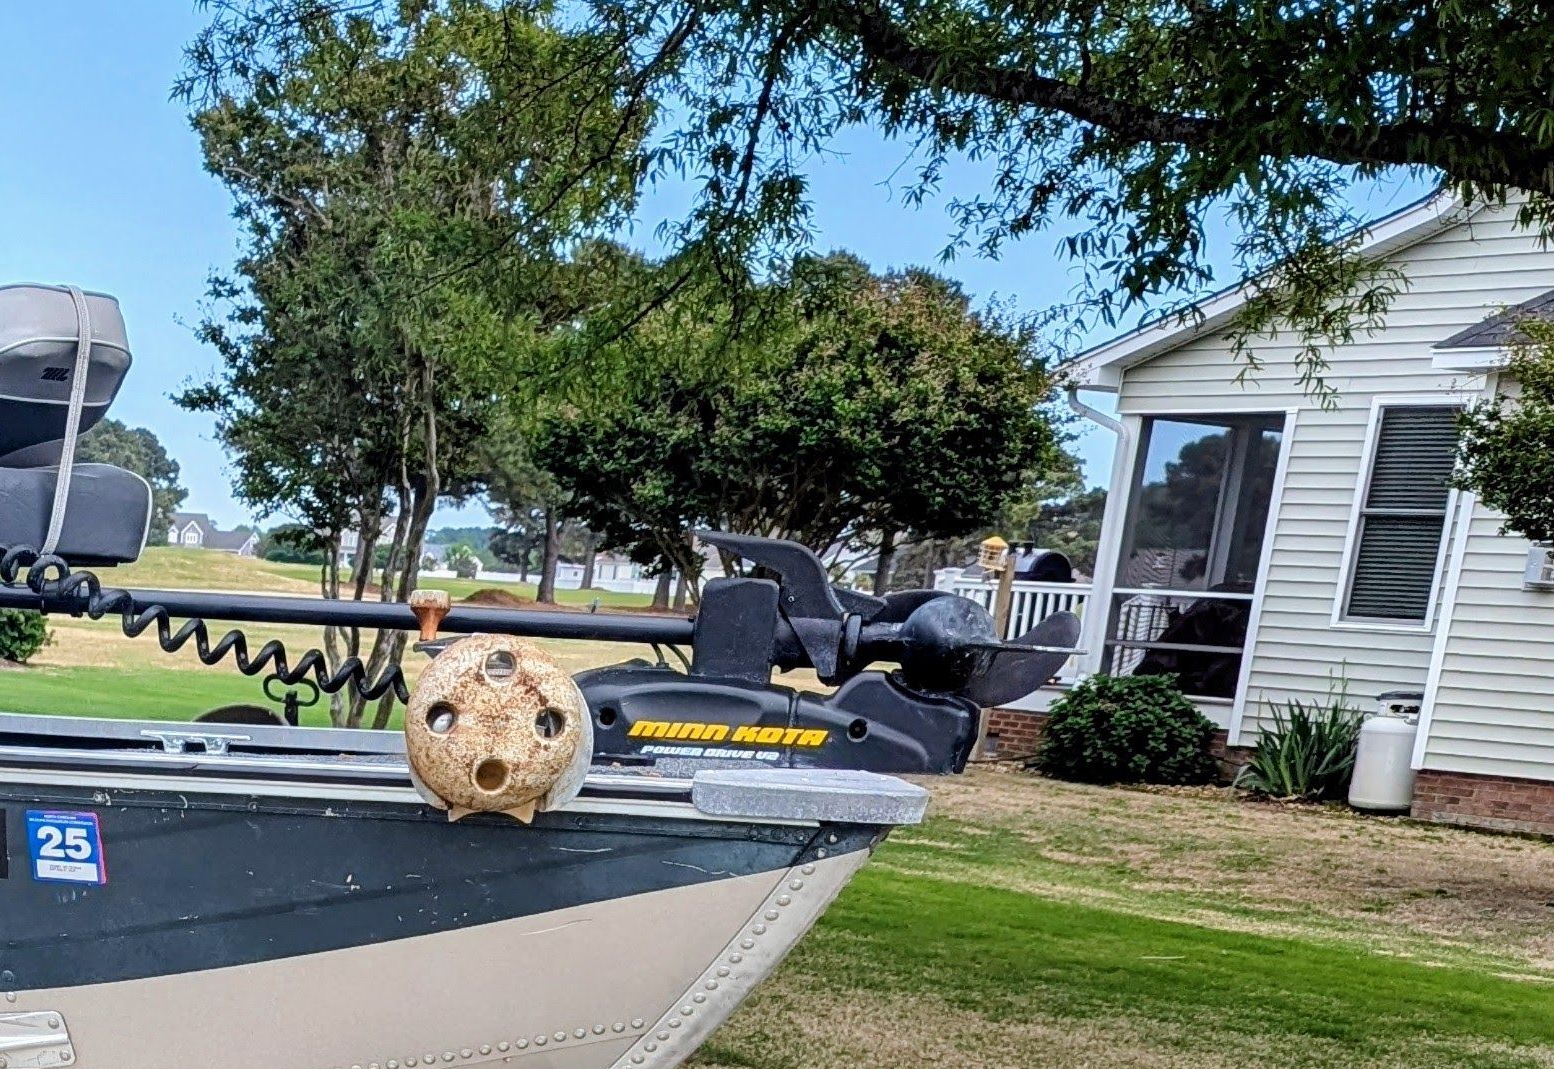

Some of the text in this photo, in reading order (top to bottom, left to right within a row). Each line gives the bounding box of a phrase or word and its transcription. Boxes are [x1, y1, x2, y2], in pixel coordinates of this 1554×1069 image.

[627, 720, 829, 746] MINN KOTA
[639, 745, 704, 756] POWER
[702, 748, 756, 760] DRIVE
[37, 825, 92, 860] 25
